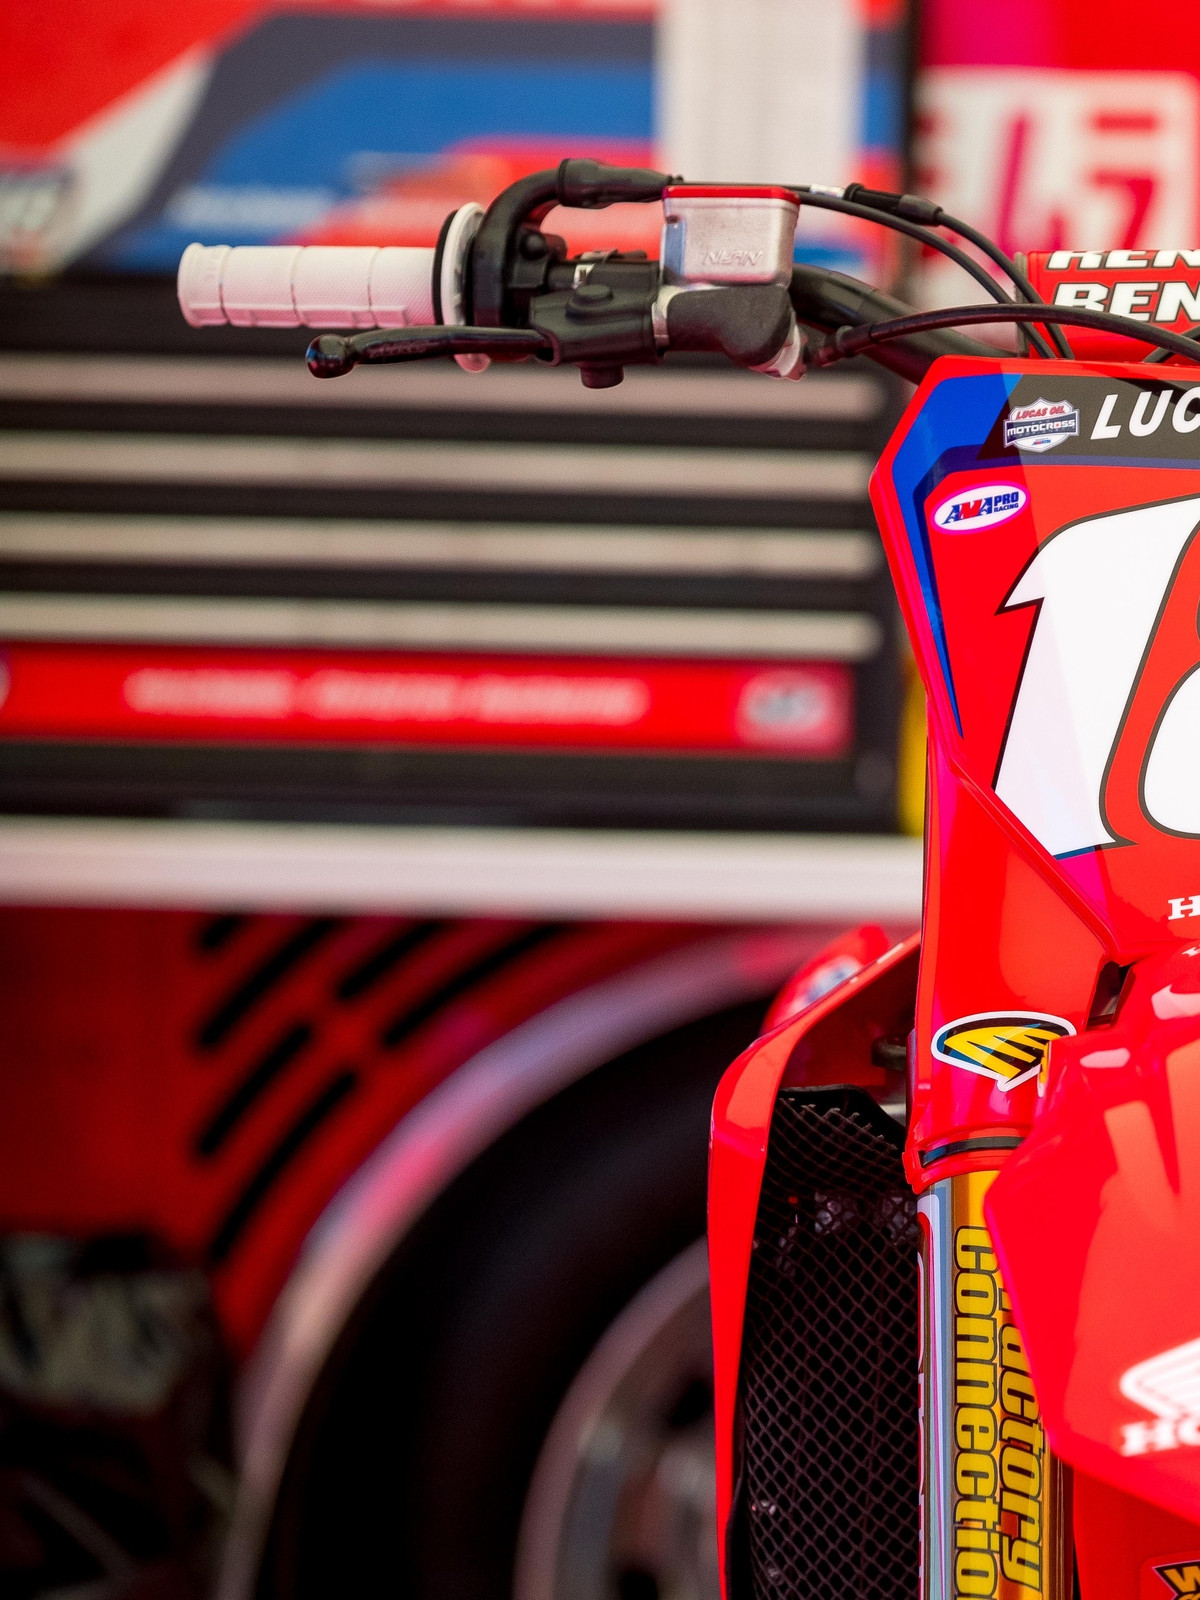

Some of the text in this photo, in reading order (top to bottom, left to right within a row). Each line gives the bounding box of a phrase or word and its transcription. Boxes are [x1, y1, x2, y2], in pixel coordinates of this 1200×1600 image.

[1017, 406, 1065, 419] LUCAS OIL
[1007, 419, 1075, 436] MOTOCROSS
[941, 491, 1019, 525] AMA PRO
[993, 502, 1019, 513] RACING
[953, 1225, 1000, 1600] Connectio
[998, 1288, 1045, 1593] actory
